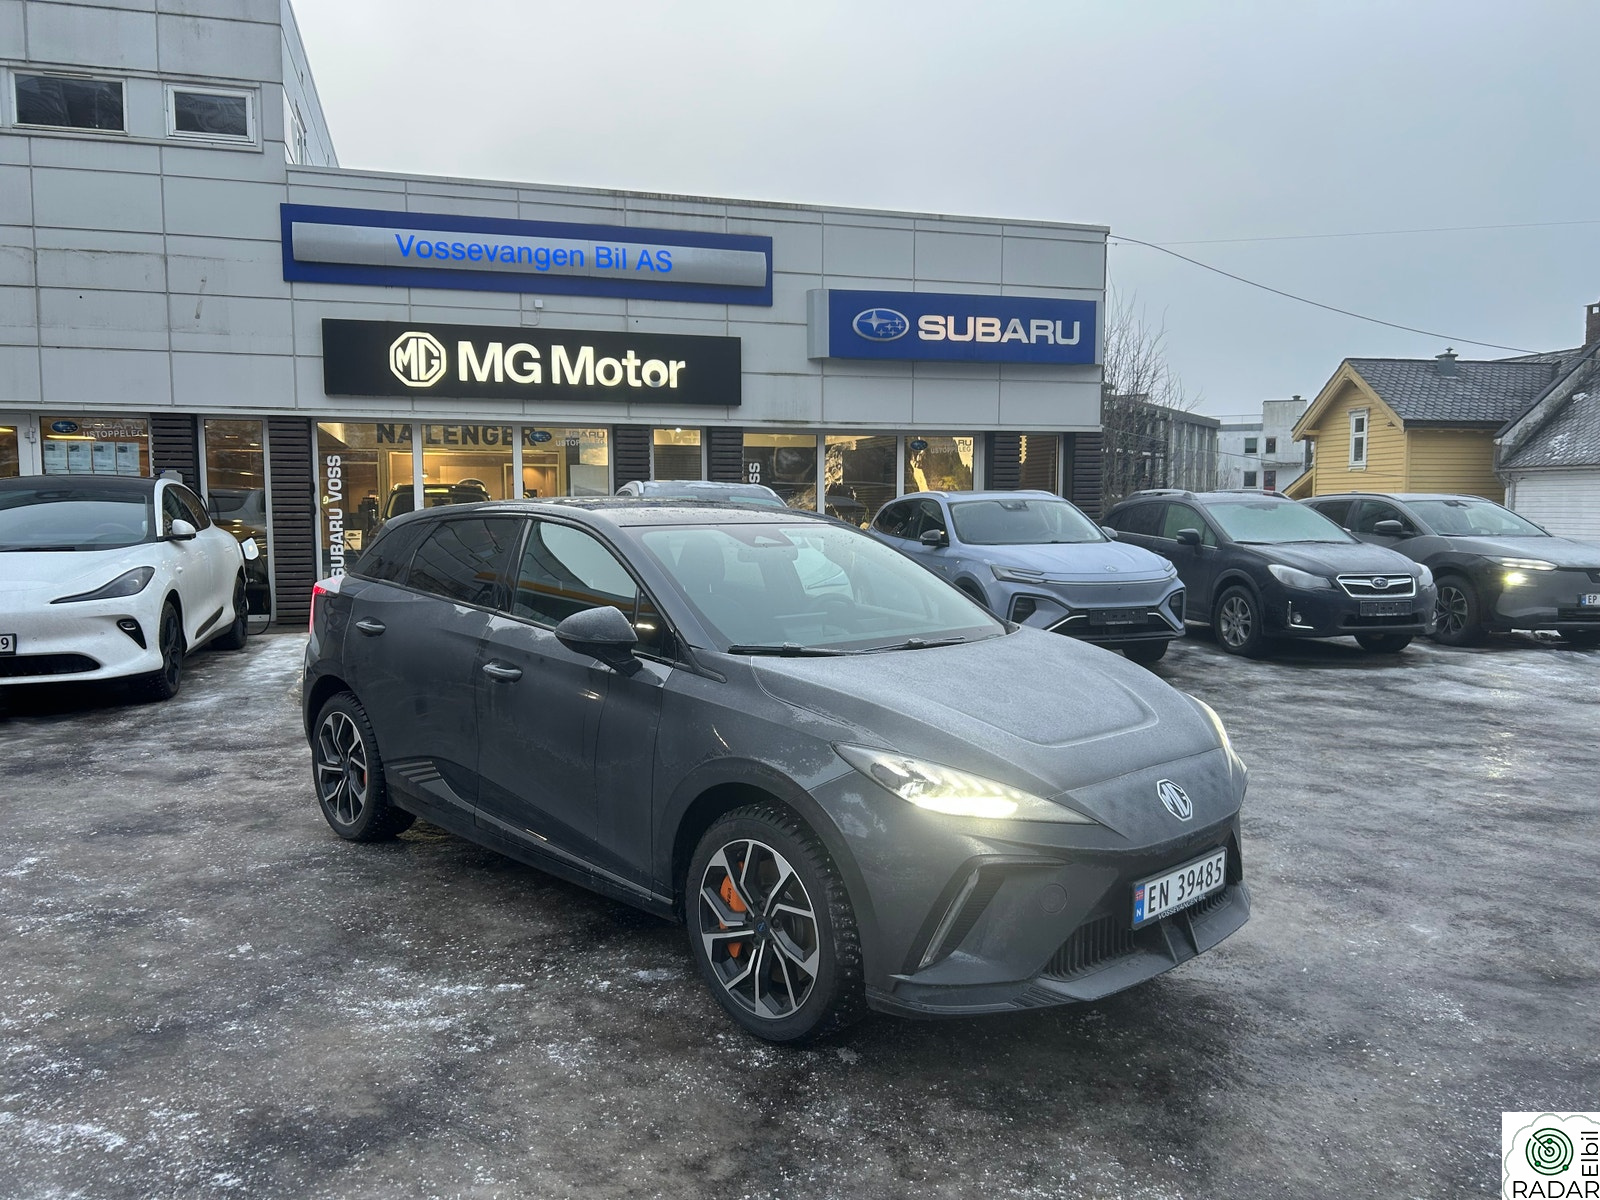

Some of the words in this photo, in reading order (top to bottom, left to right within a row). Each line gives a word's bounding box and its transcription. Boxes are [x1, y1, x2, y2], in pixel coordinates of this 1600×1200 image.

[395, 233, 584, 271] Vossevangen
[595, 246, 627, 270] Bil
[635, 249, 672, 273] AS
[918, 314, 1080, 346] SUBARU
[392, 334, 443, 384] MG
[457, 341, 542, 384] MG
[551, 344, 686, 388] Motor
[327, 455, 343, 503] VOSS
[329, 508, 345, 577] SUBARU
[1588, 595, 1598, 604] EP
[1158, 781, 1191, 819] MG
[1148, 880, 1169, 914] EN
[1177, 857, 1222, 902] 39485
[1136, 909, 1142, 918] N
